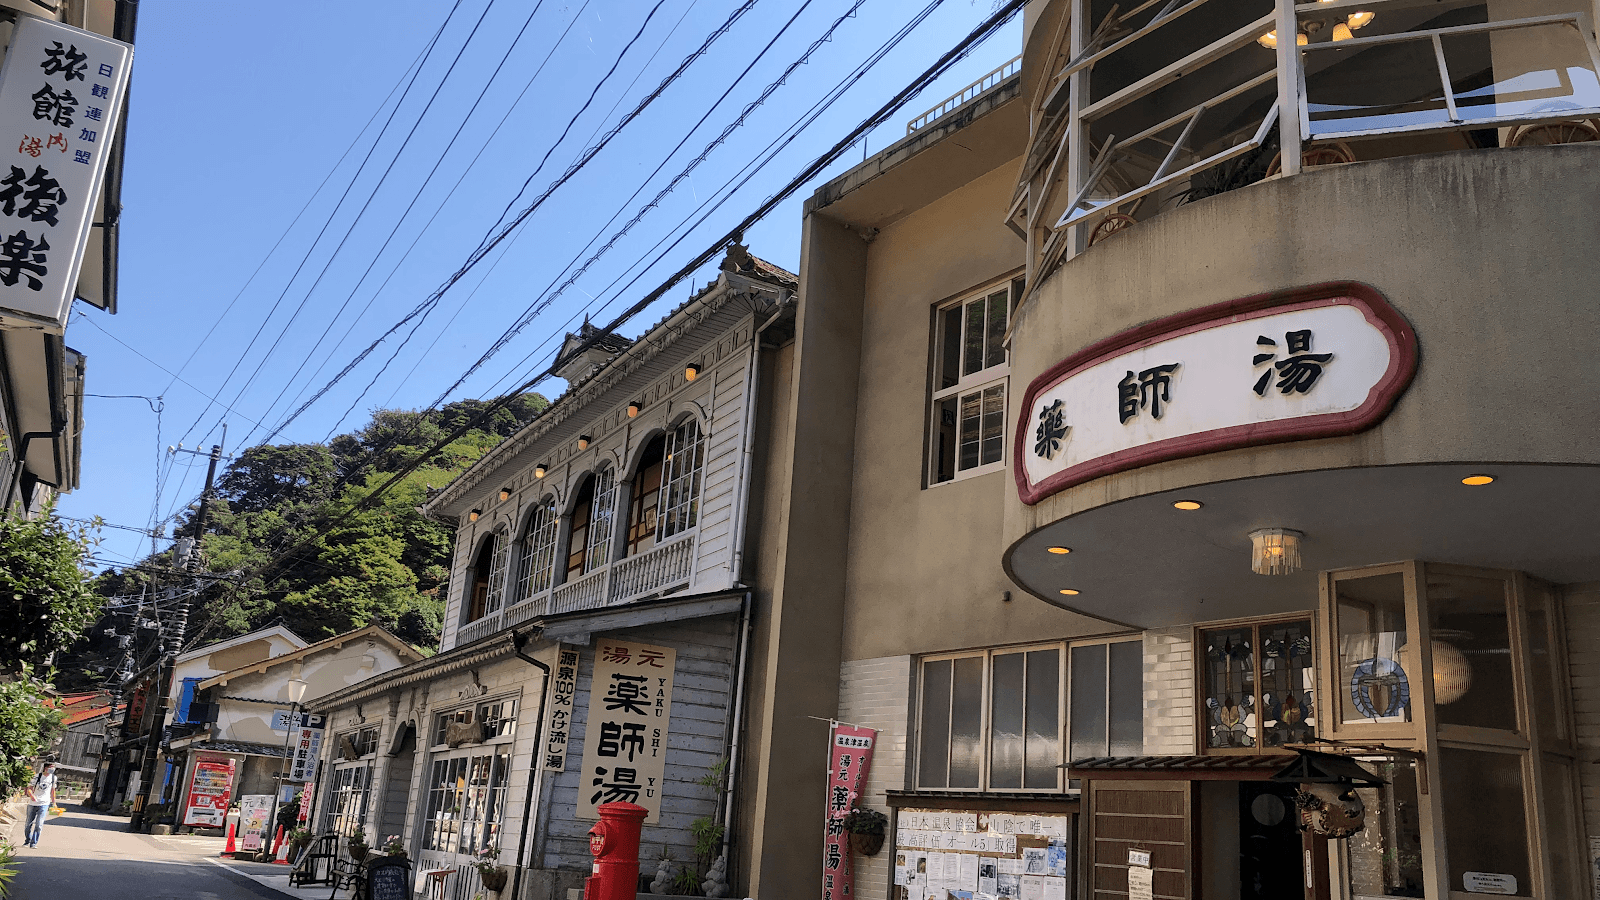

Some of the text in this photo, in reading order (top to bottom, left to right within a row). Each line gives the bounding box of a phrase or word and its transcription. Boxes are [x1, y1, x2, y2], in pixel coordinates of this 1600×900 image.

[32, 41, 88, 129] 旅館
[73, 63, 114, 165] 日観連加盟
[602, 646, 666, 669] 湯元
[307, 715, 322, 726] P
[590, 672, 652, 805] 薬師湯
[646, 677, 667, 798] YAKU SHI YU
[837, 736, 870, 748] 温泉津温泉
[837, 754, 851, 781] 湯元
[826, 786, 849, 871] 薬師湯
